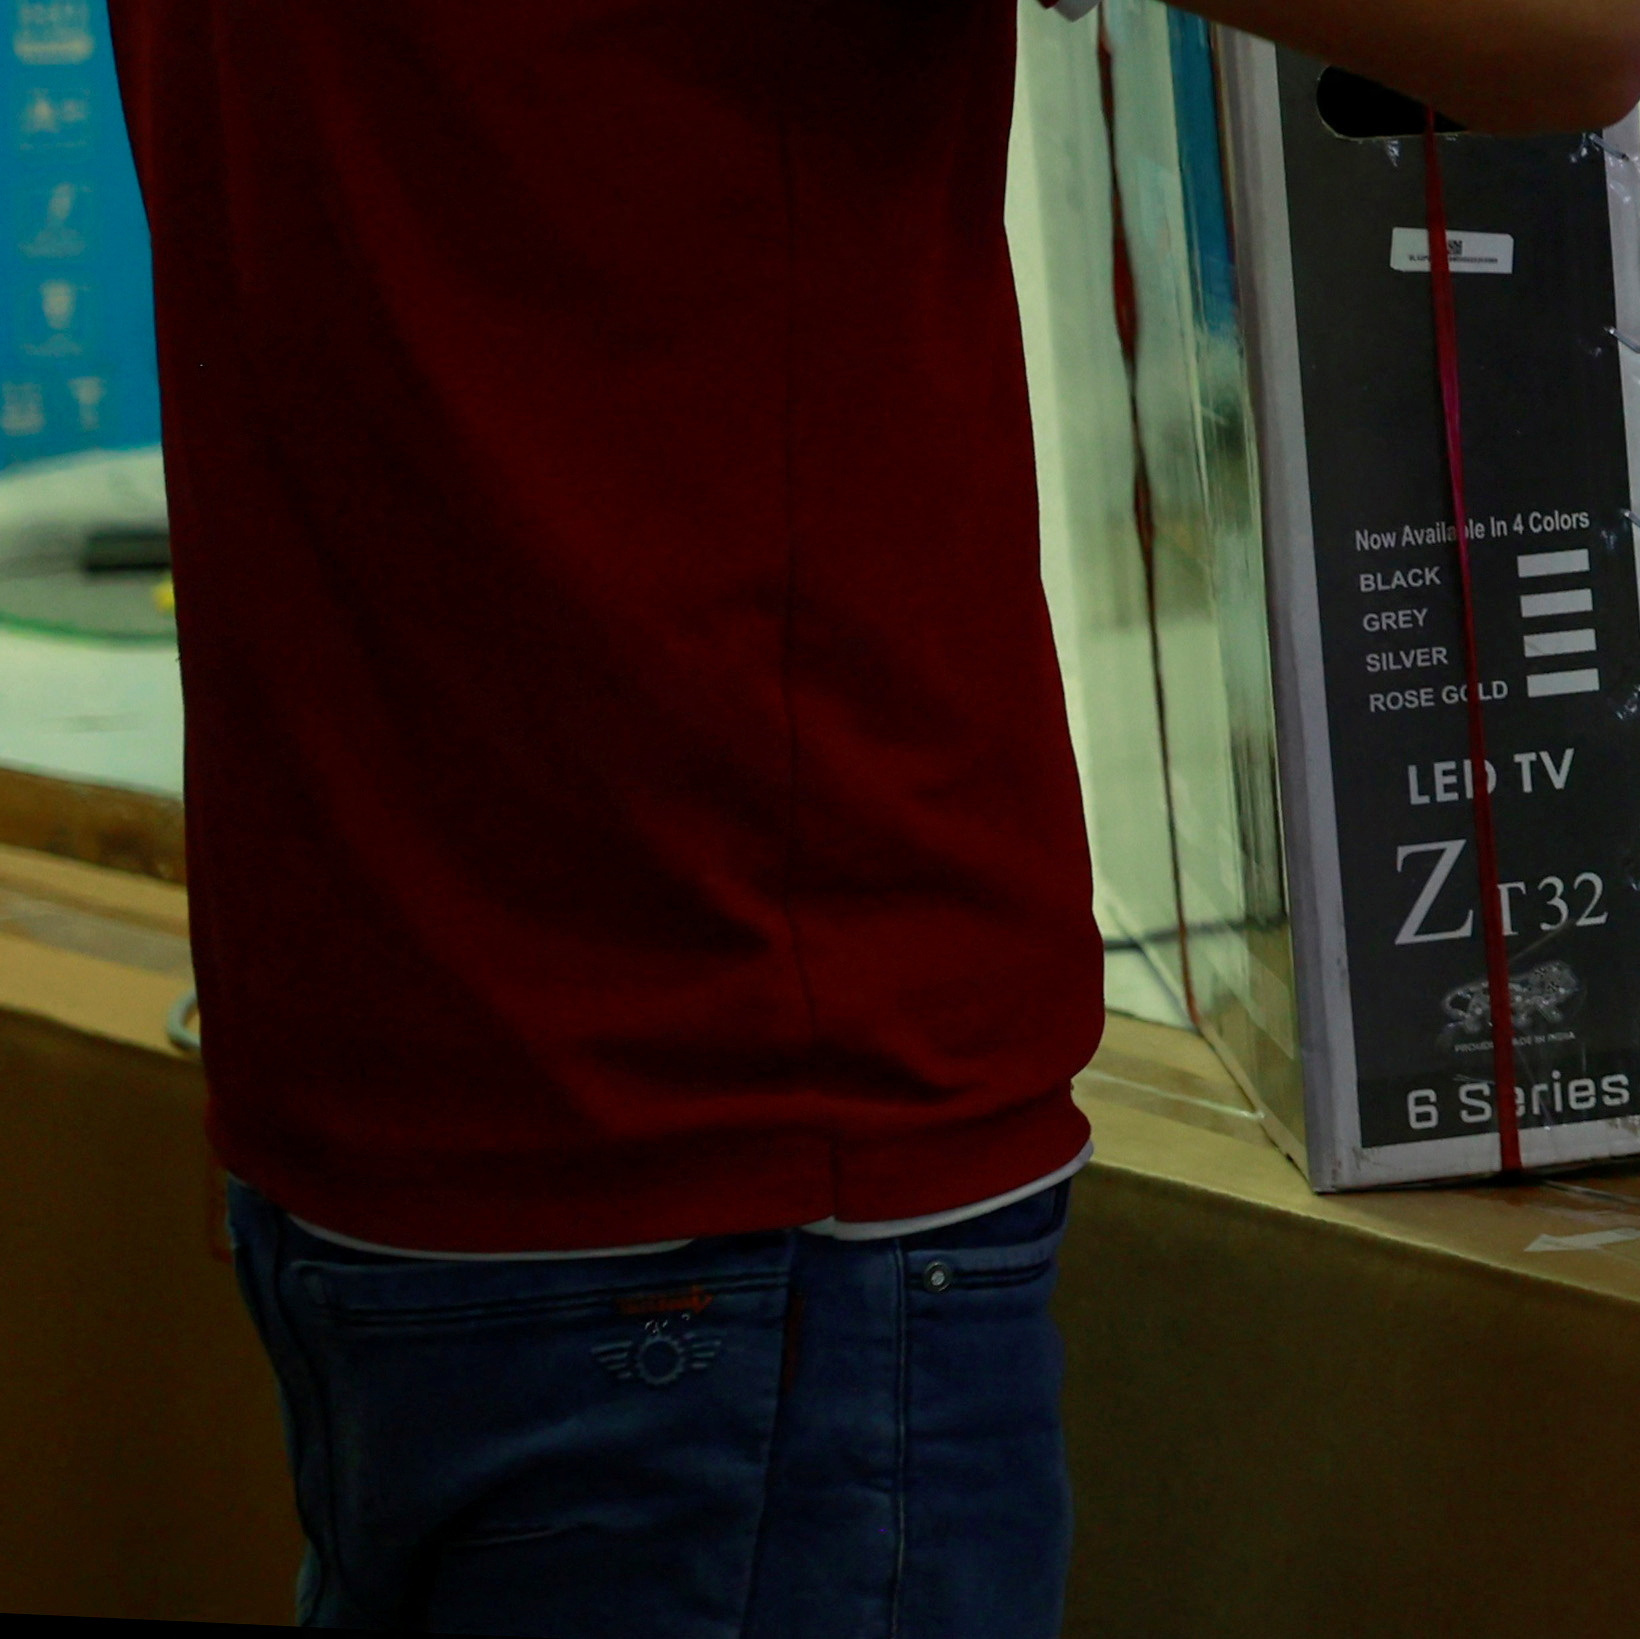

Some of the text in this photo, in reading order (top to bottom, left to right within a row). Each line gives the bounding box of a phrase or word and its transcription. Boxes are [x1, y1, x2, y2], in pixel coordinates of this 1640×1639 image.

[1355, 510, 1591, 551] Now Availale In 4 Colors
[1359, 566, 1442, 593] BLACK
[1363, 608, 1429, 633] GREY
[1366, 646, 1448, 673] SILVER
[1369, 687, 1435, 713] ROSE
[1407, 747, 1576, 806] LED TV
[1407, 1088, 1439, 1131] 6
